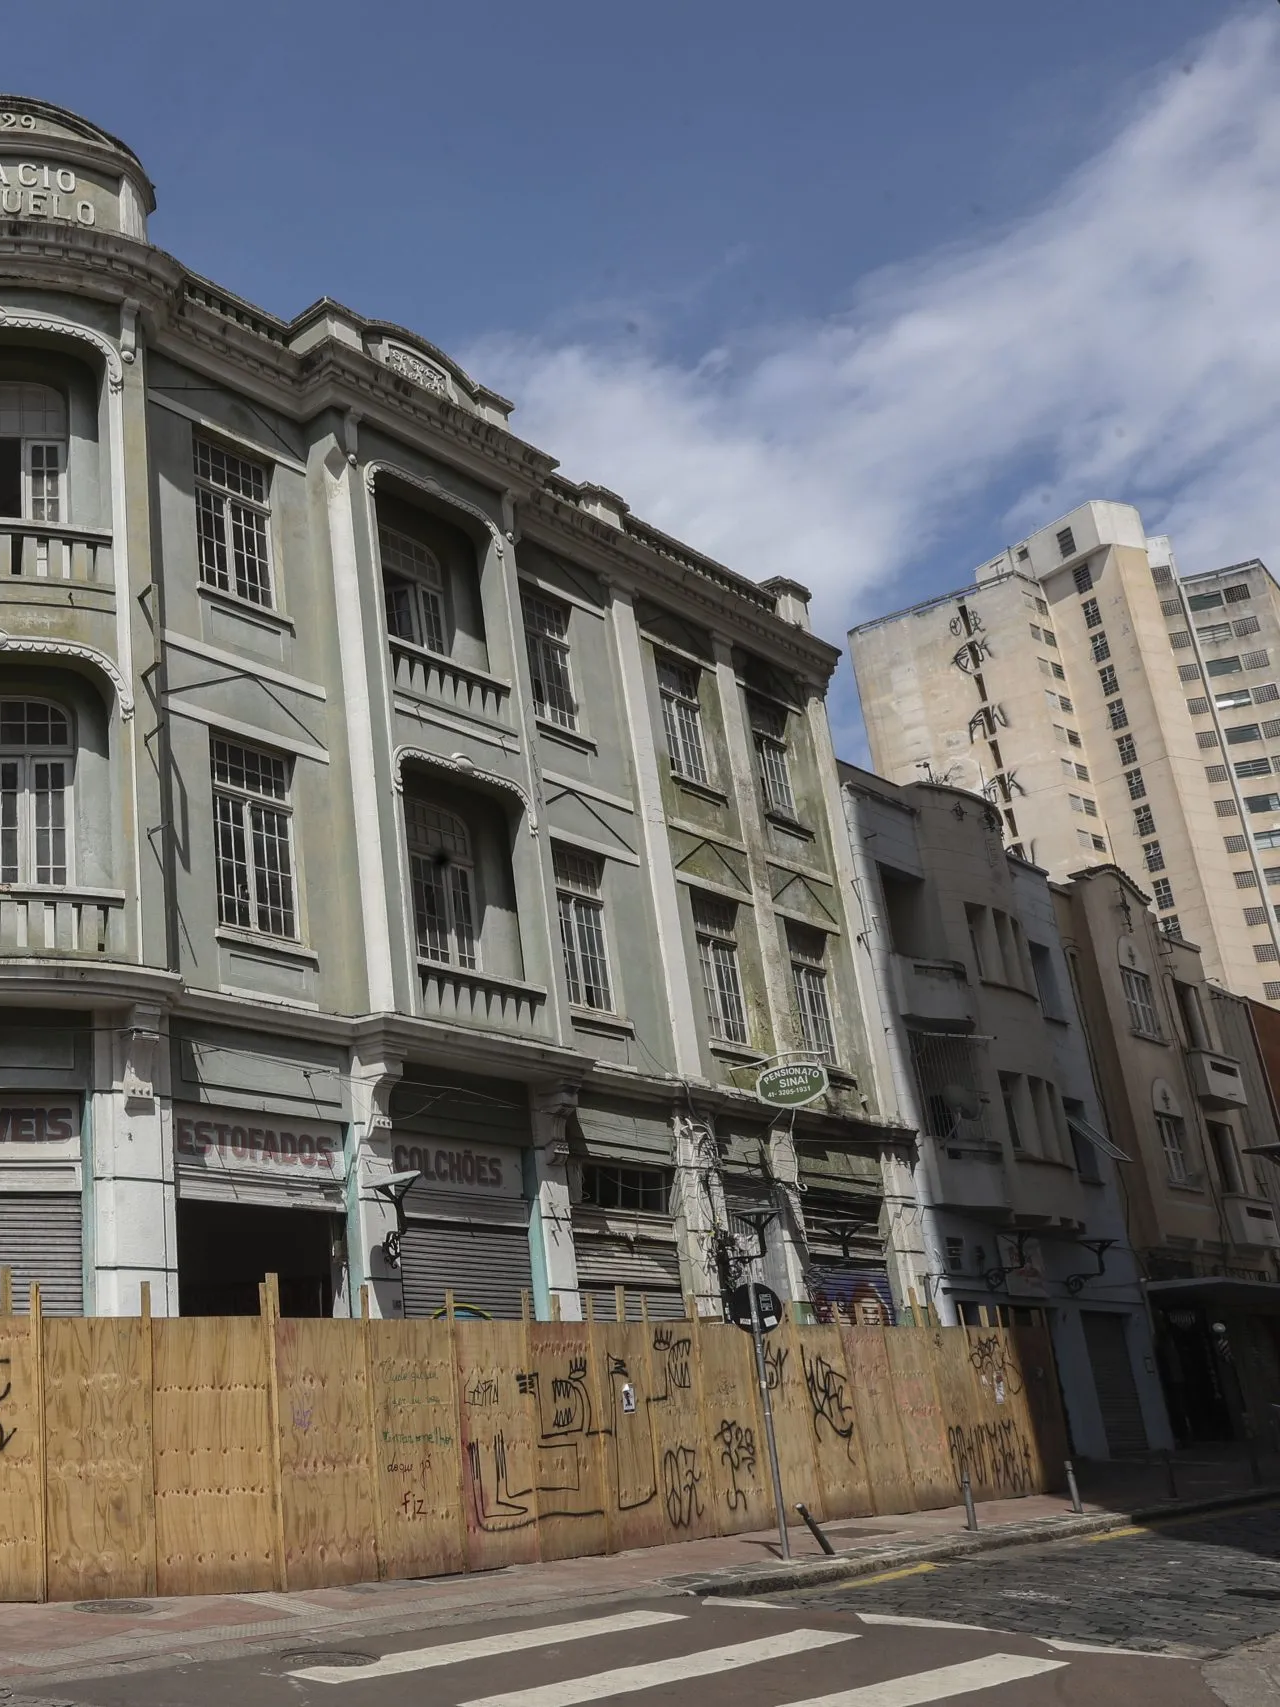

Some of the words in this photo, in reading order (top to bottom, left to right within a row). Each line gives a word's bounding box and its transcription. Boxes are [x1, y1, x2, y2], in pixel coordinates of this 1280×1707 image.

[763, 1067, 819, 1085] PENSIONATO
[176, 1118, 336, 1170] ESTOFADOS
[393, 1145, 503, 1189] COLCHÕES
[402, 1490, 428, 1515] fiz
